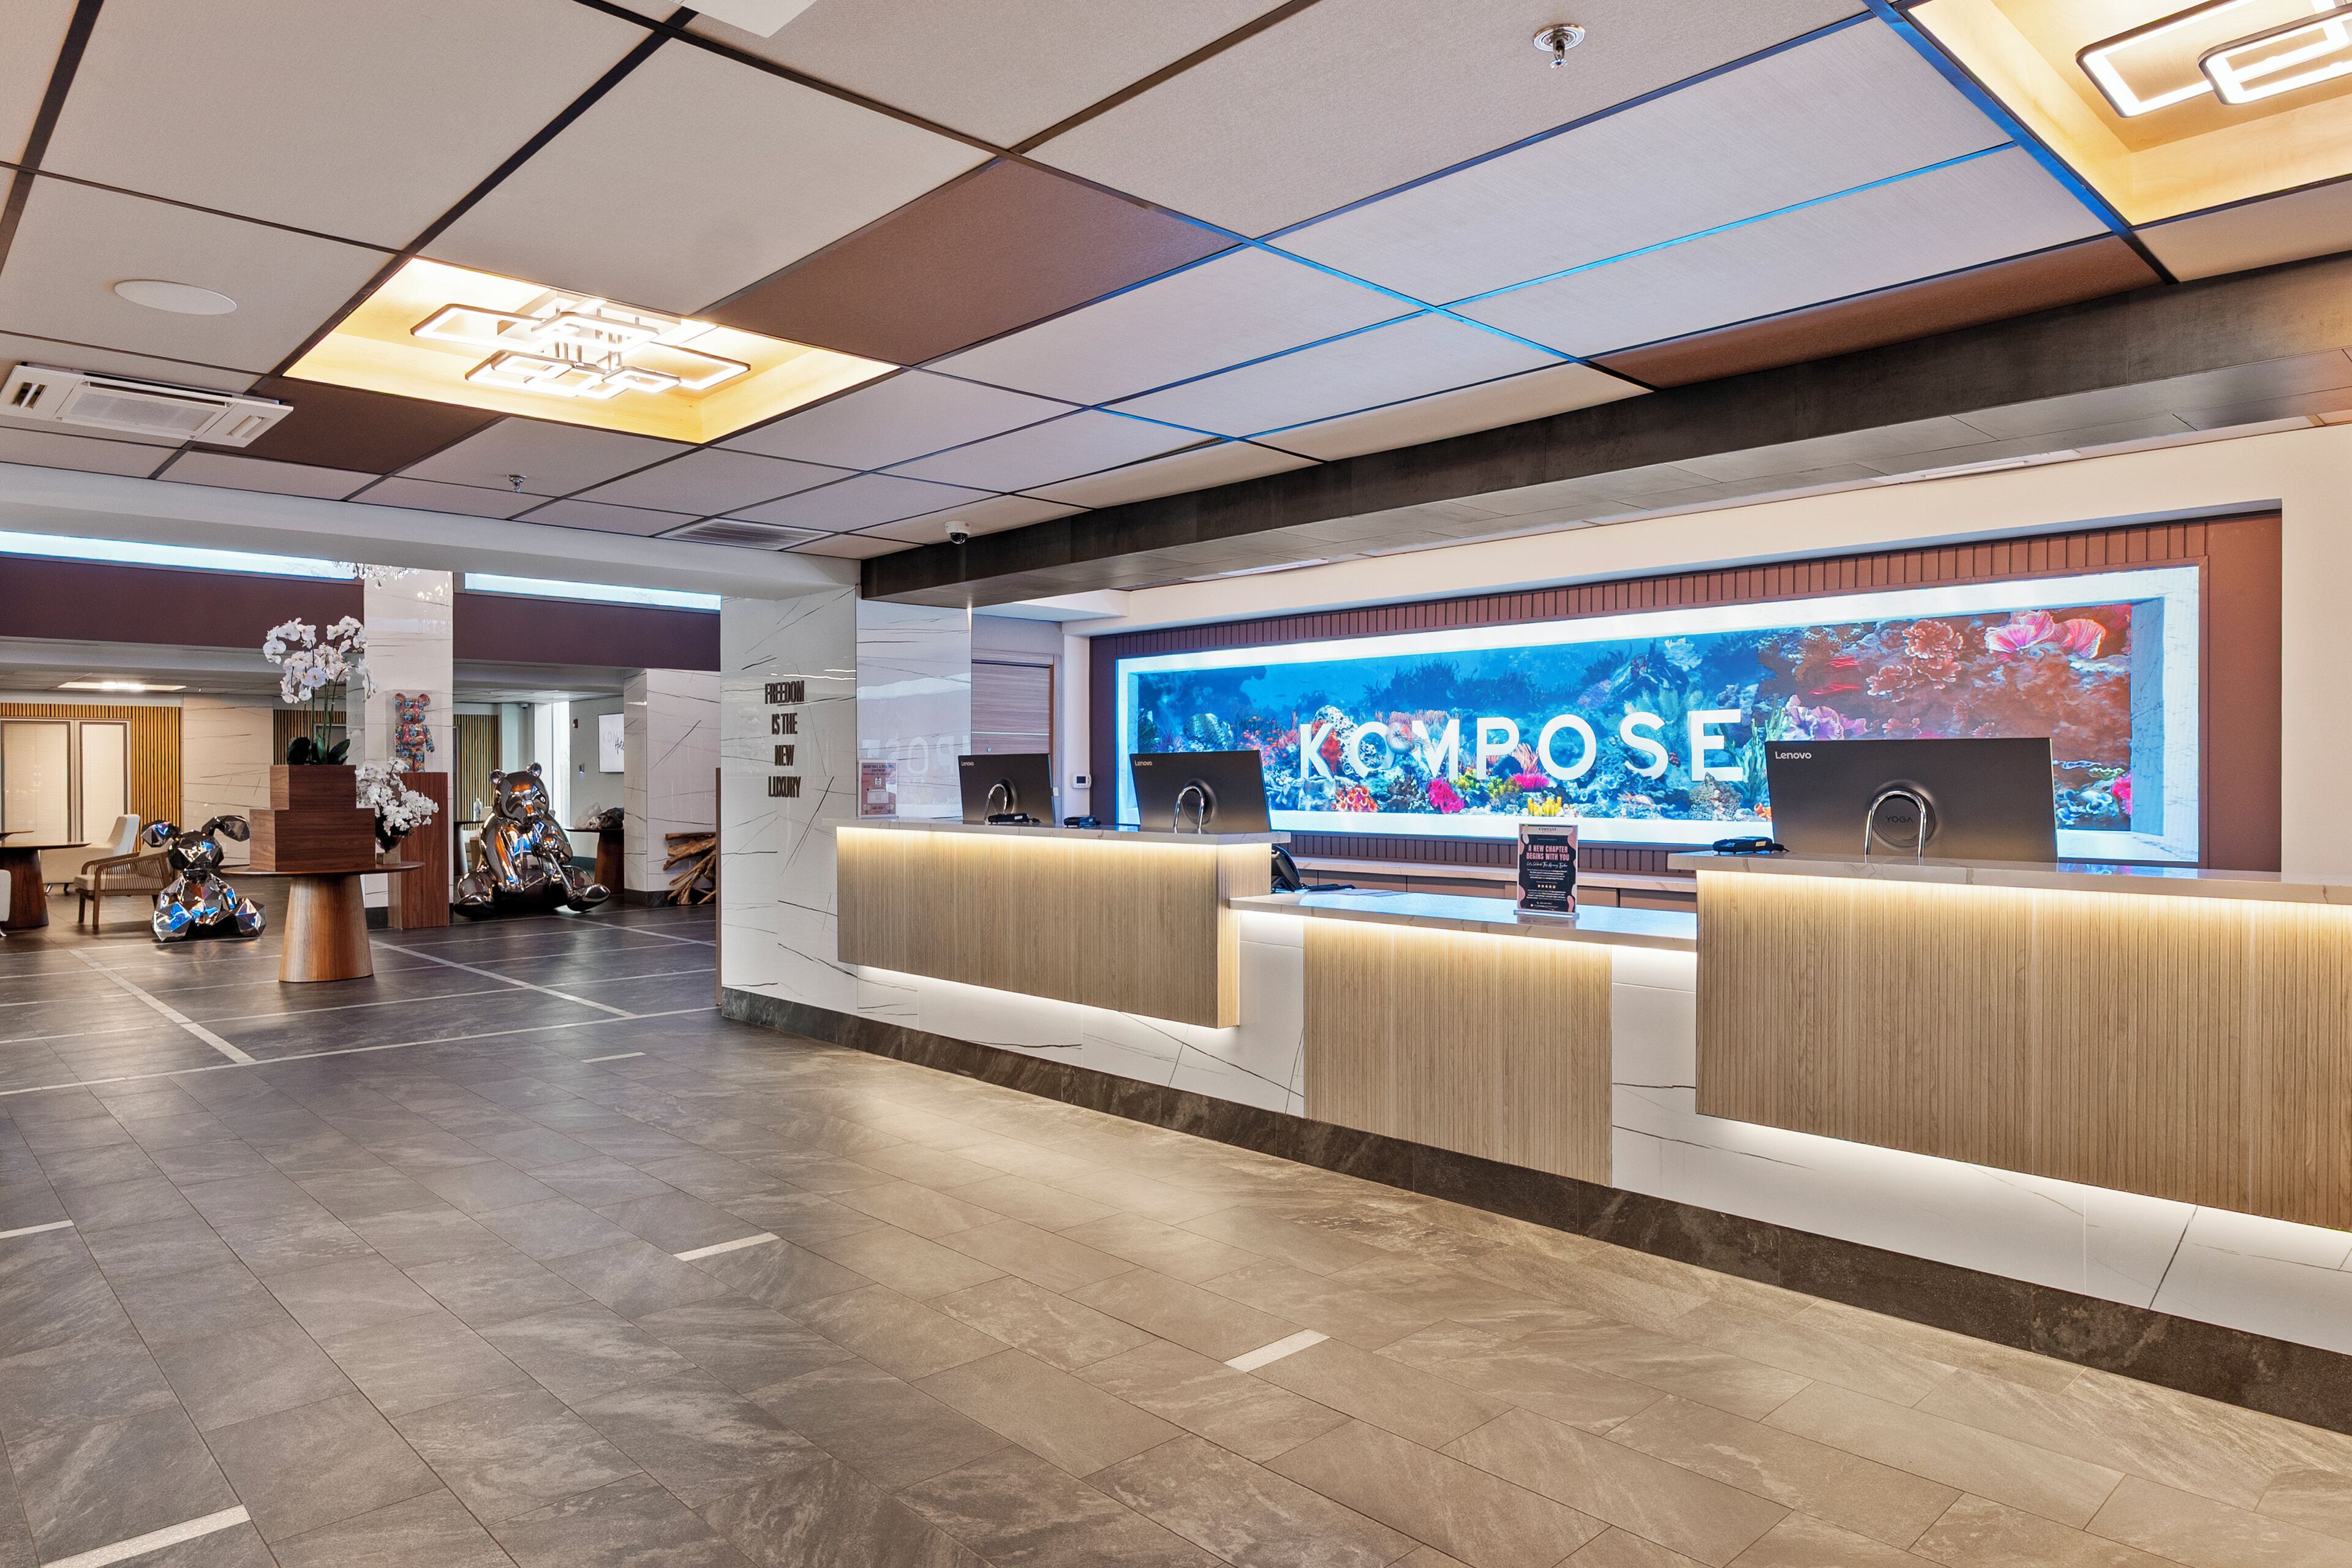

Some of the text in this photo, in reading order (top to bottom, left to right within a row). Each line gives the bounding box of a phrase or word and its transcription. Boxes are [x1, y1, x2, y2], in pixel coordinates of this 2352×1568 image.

[764, 680, 805, 704] FREEDOM
[771, 712, 798, 735] IS THE
[775, 745, 794, 766] NEW
[1299, 708, 1743, 782] KOMPOSE
[1774, 751, 1812, 760] Lenovo
[768, 776, 801, 797] LUXURY
